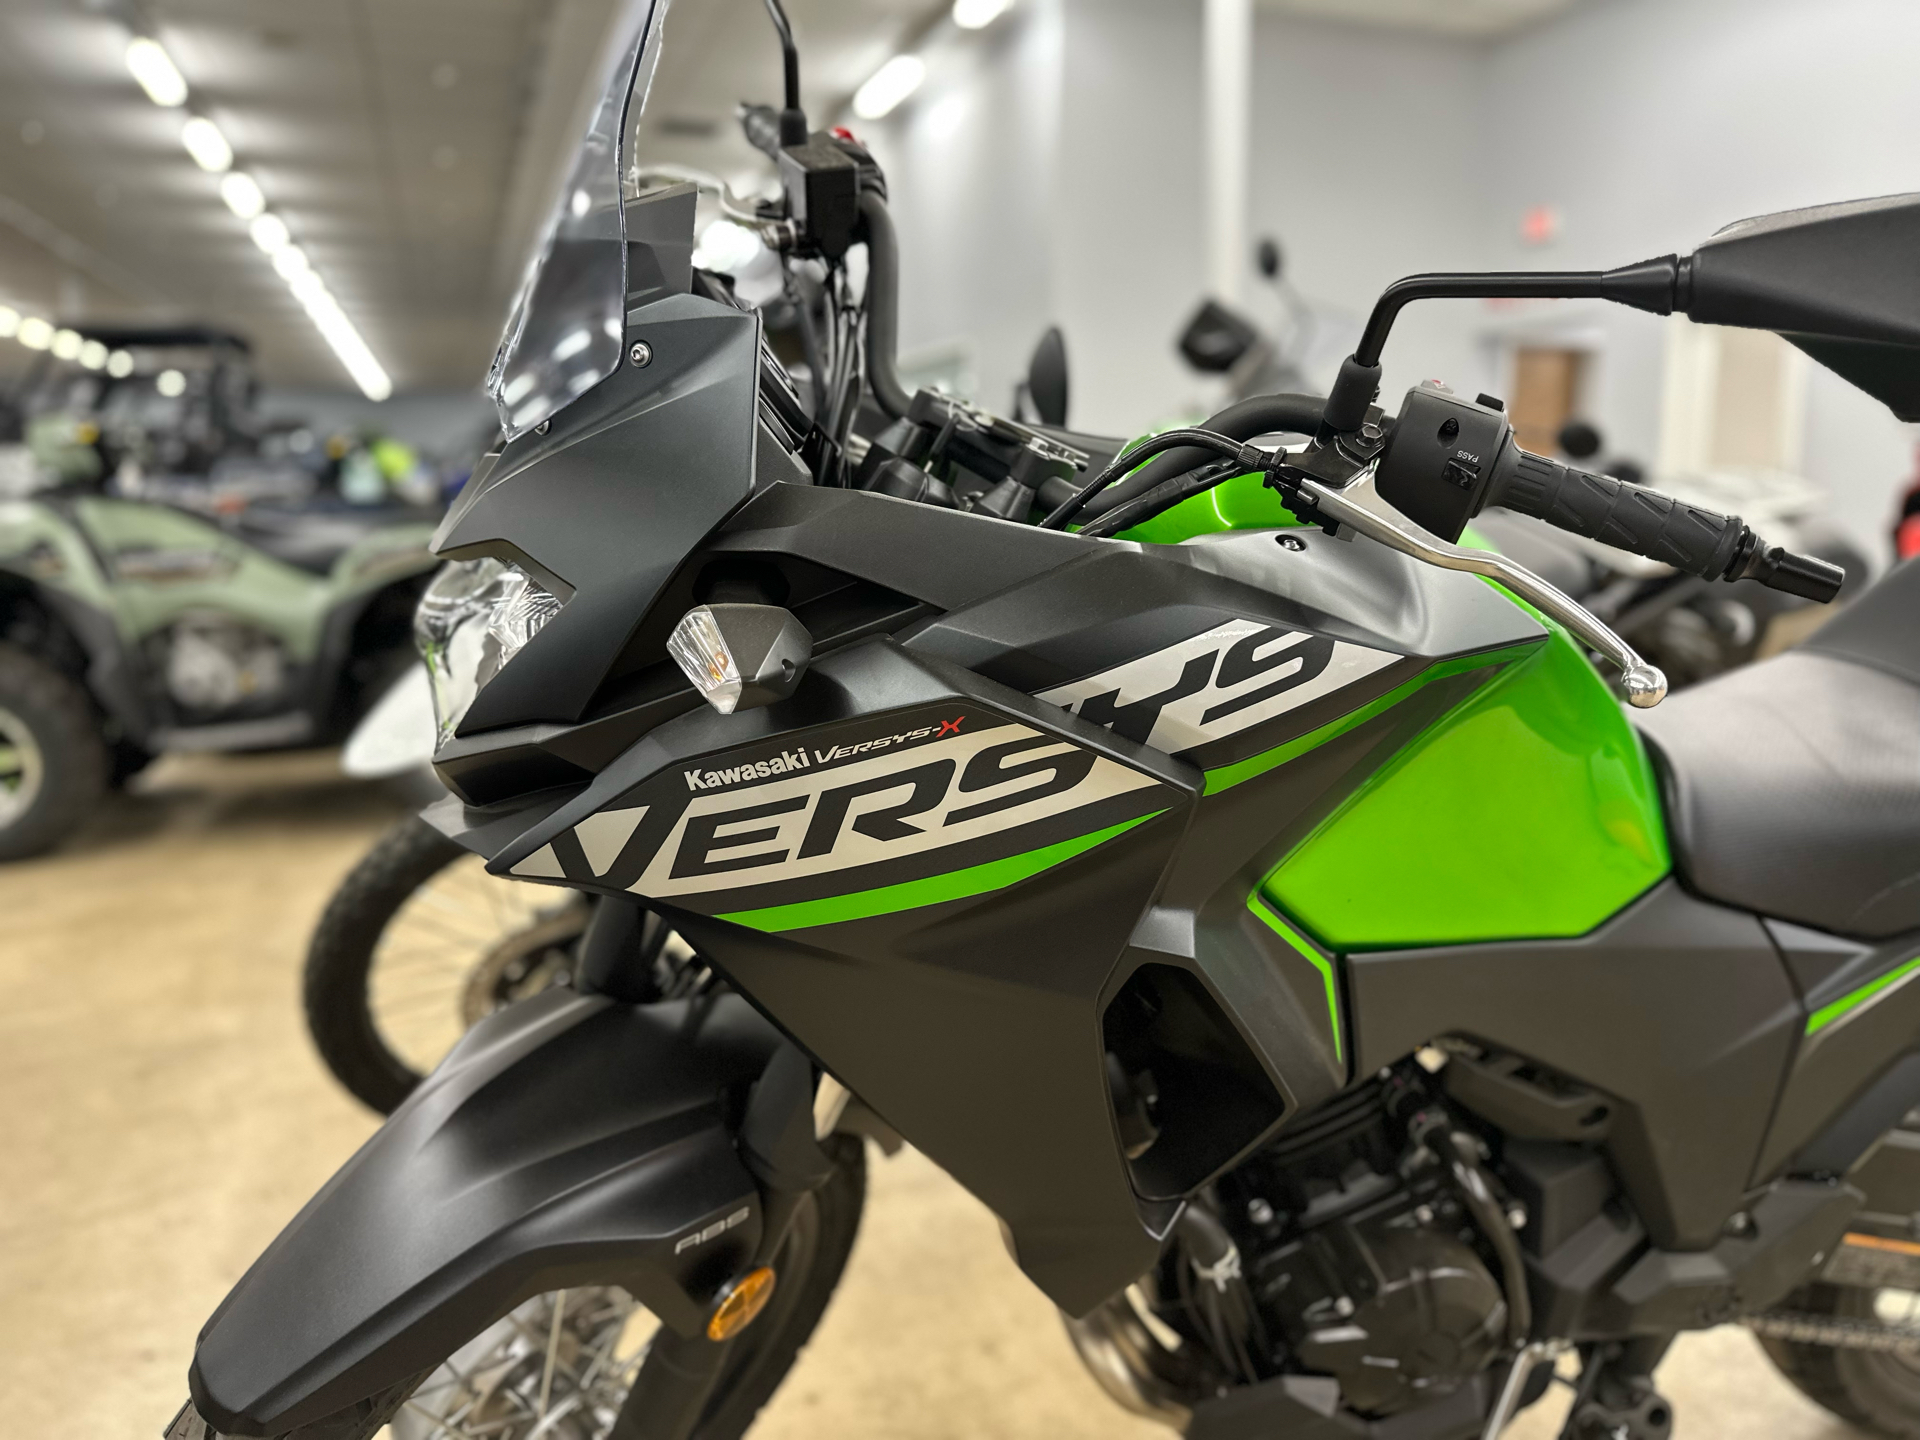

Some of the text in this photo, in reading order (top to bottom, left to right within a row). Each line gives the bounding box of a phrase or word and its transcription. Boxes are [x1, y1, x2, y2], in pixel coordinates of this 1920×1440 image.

[1457, 450, 1479, 463] PASS
[684, 716, 965, 791] Kawasaki VERSYS-X
[675, 1206, 750, 1255] ABS
